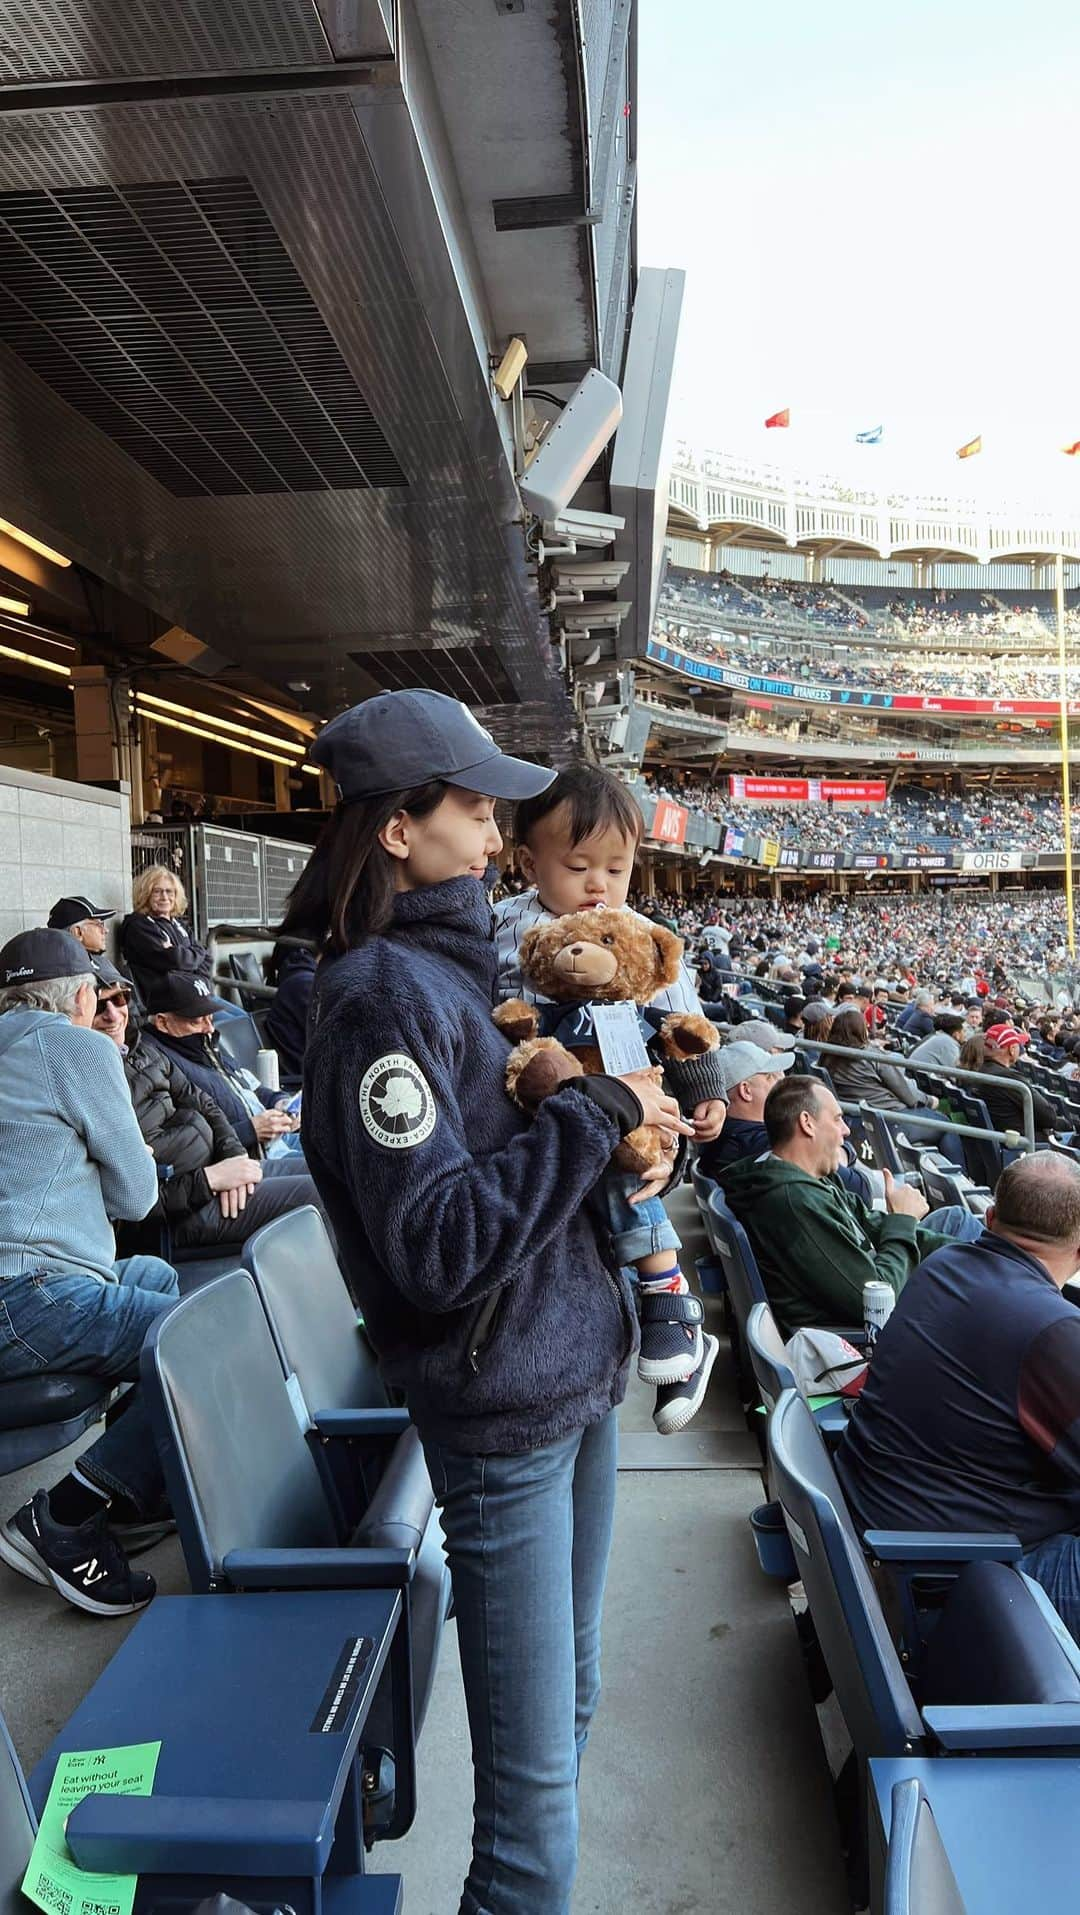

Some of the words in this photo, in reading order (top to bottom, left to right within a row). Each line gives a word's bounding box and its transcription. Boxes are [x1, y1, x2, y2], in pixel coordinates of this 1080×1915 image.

[684, 659, 709, 677] FOLLOW
[723, 671, 749, 688] YANKEES
[750, 678, 761, 690] ON
[762, 680, 792, 695] TWITTER
[793, 685, 831, 701] @YANKEES
[660, 806, 681, 839] AVIS
[973, 854, 1010, 869] ORIS
[361, 1084, 369, 1102] THE
[368, 1060, 399, 1080] NORTH
[403, 1060, 422, 1078] FACE
[363, 1109, 409, 1144] EXPEDITION
[61, 1782, 97, 1793] leaving
[98, 1780, 121, 1792] your
[122, 1774, 144, 1786] seat
[63, 1775, 81, 1785] Eat
[81, 1770, 118, 1783] without
